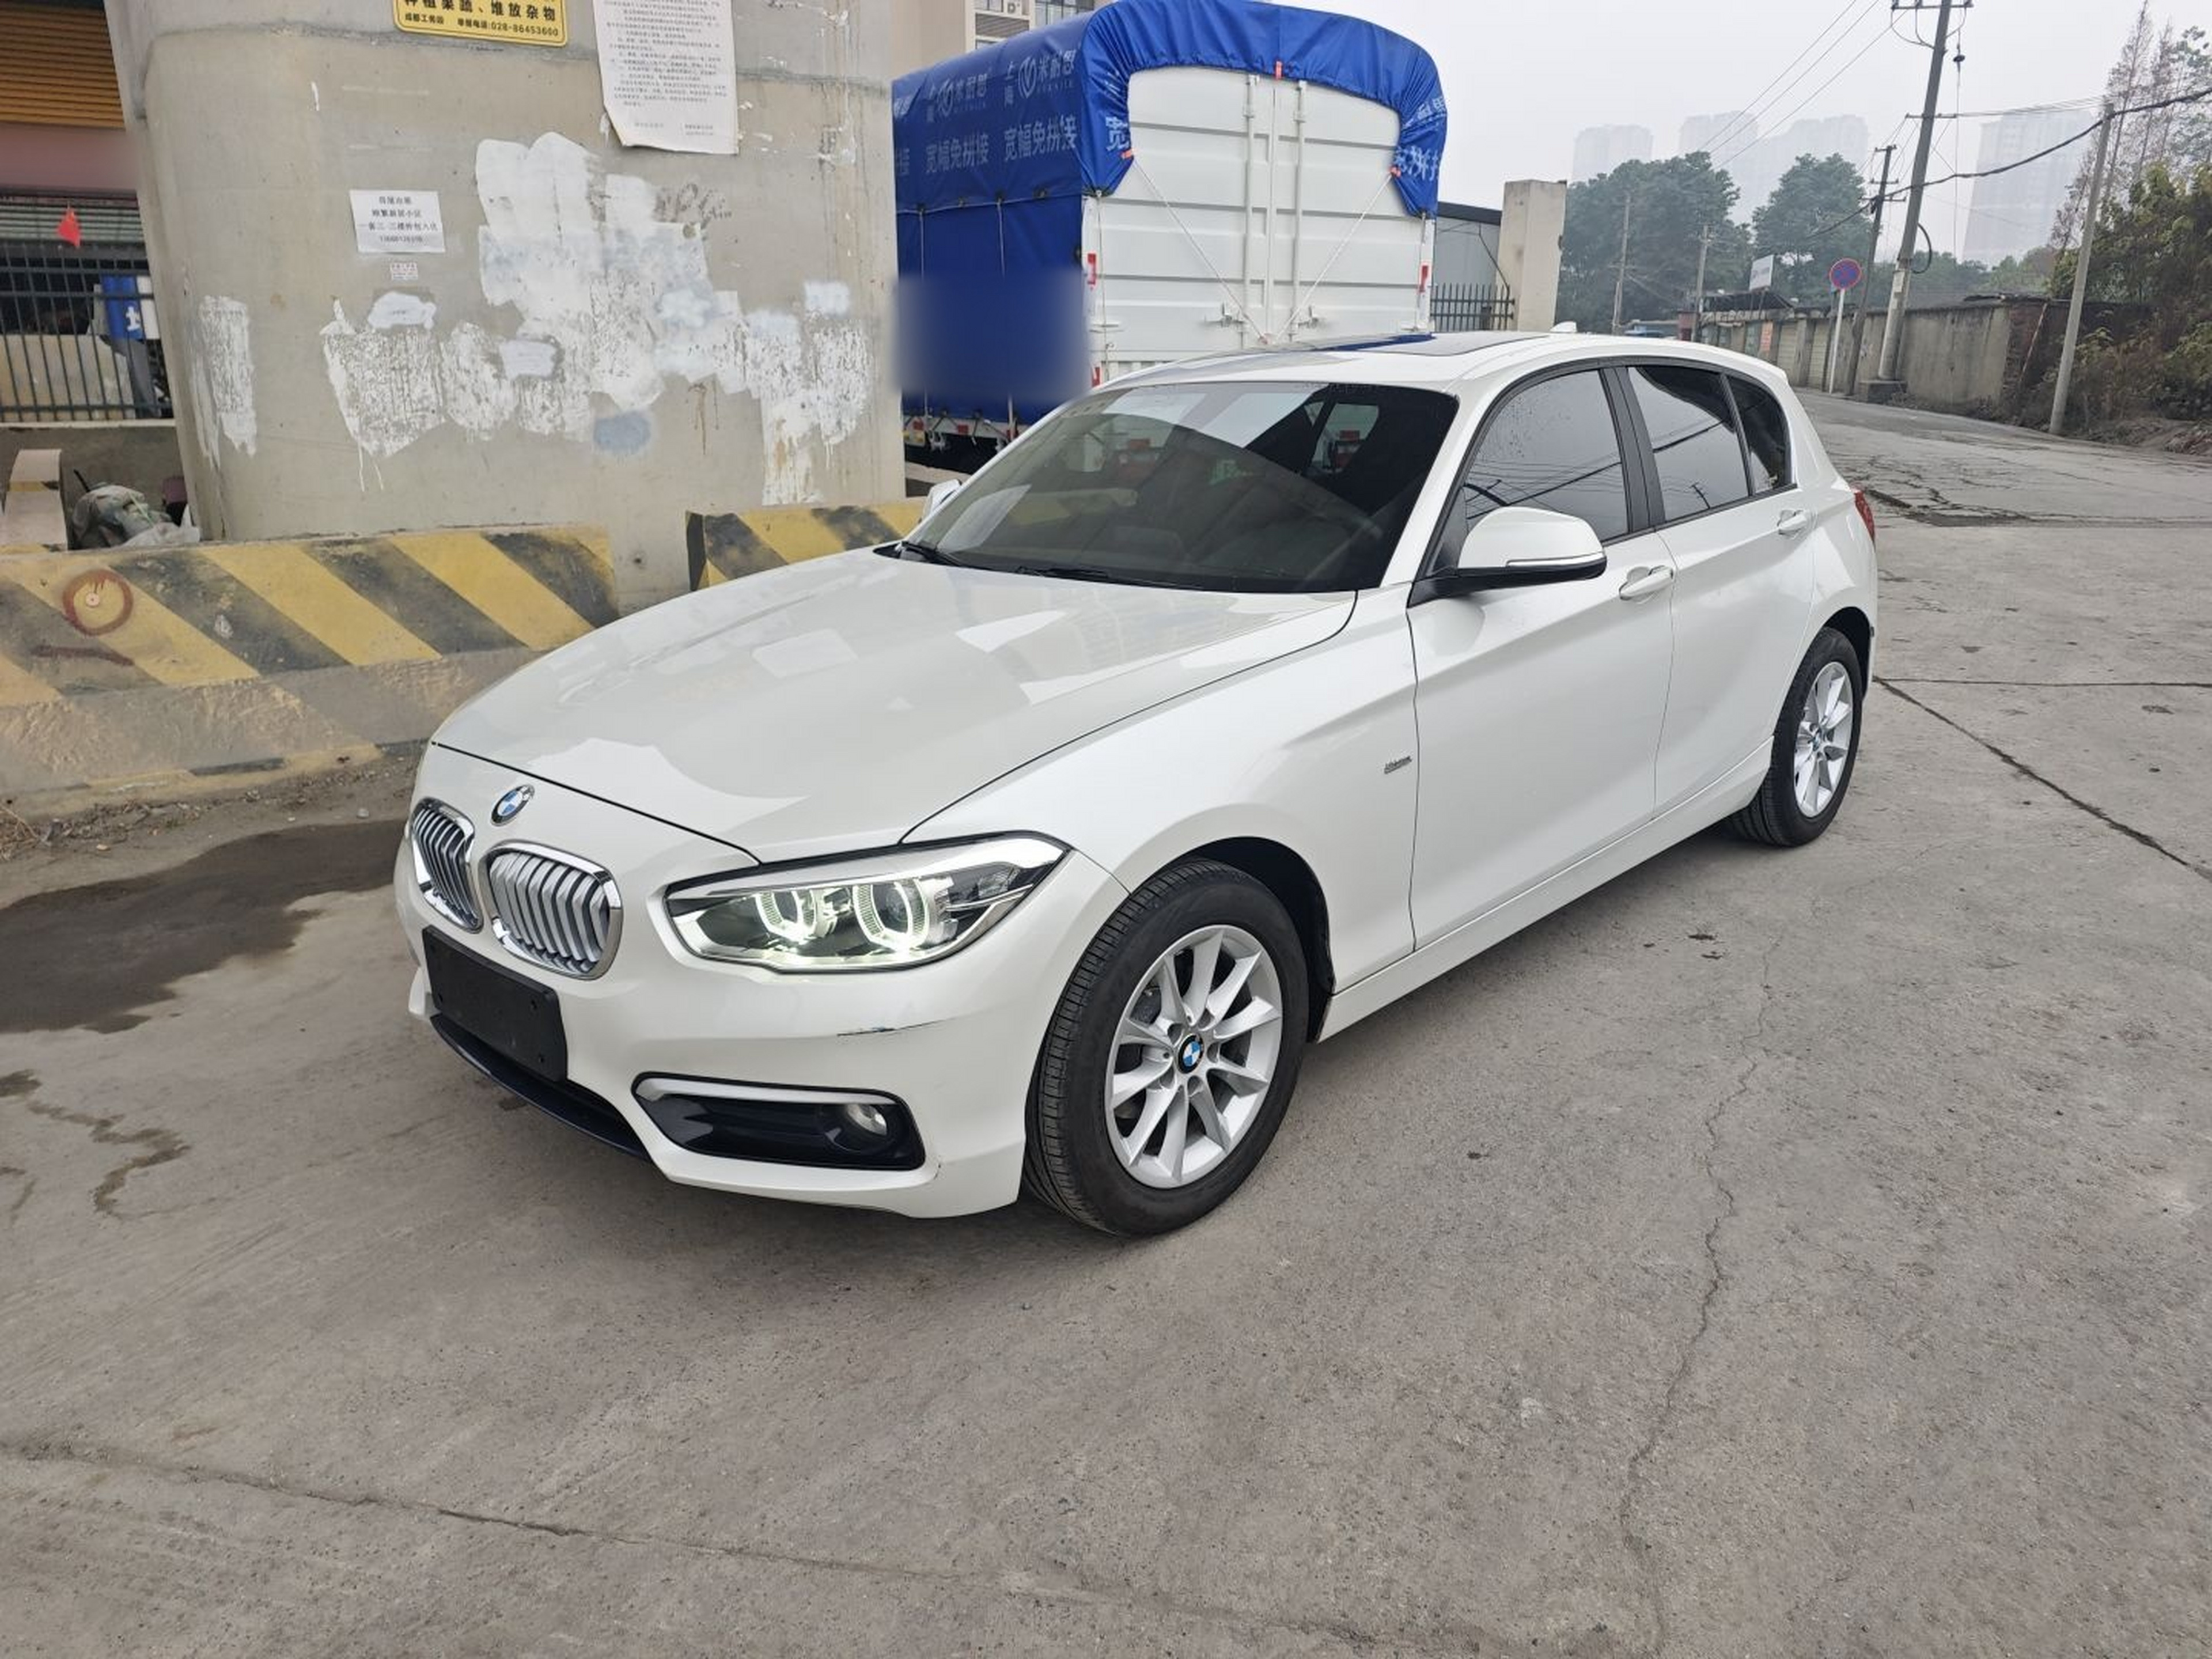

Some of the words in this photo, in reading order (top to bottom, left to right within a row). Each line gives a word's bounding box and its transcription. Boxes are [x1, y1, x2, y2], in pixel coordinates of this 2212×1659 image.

[1004, 115, 1077, 161] 宽幅免拼接
